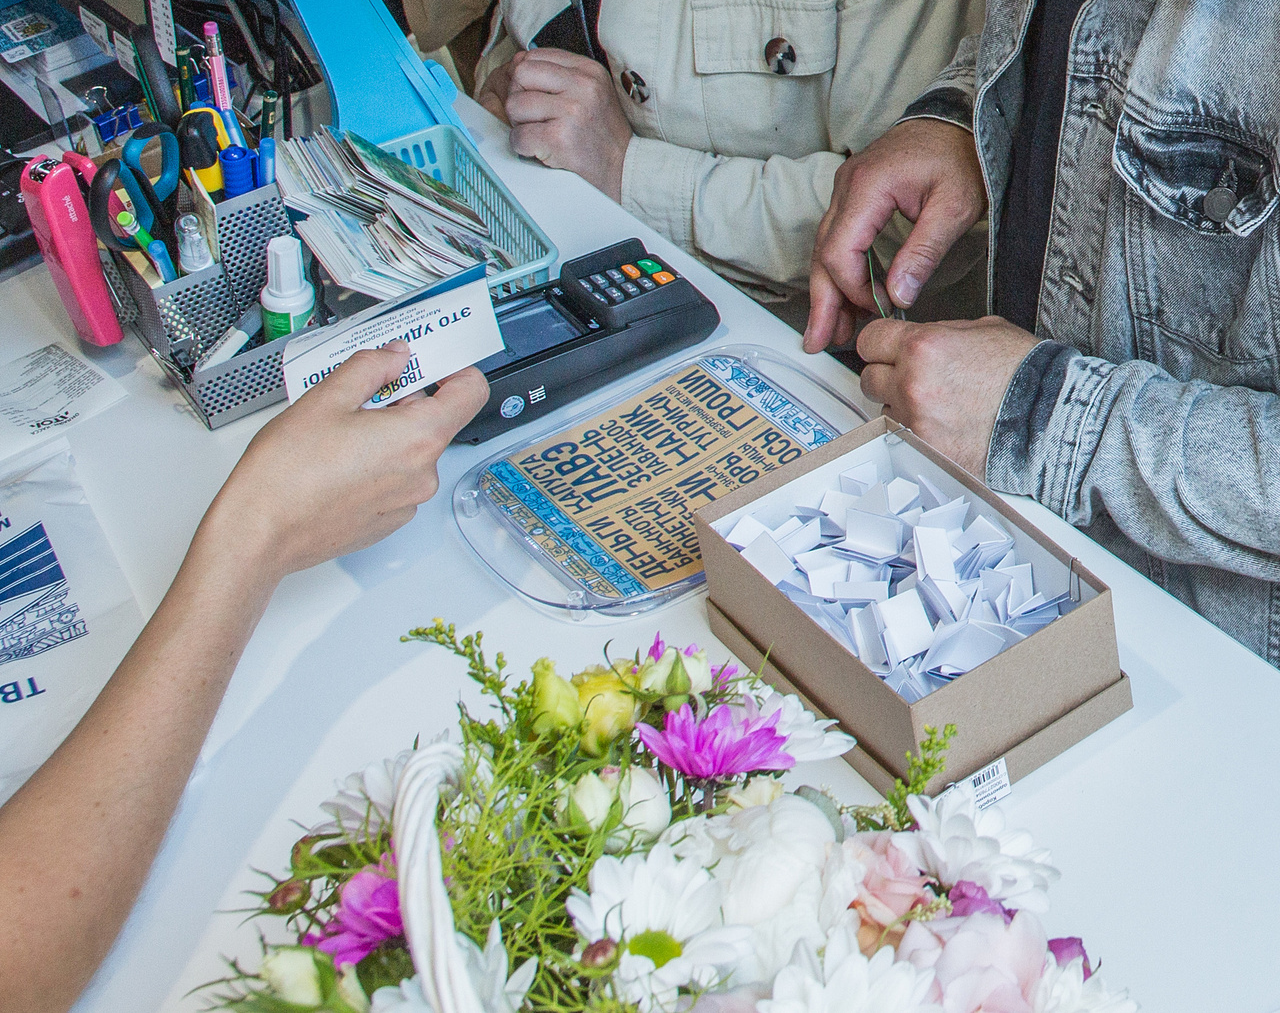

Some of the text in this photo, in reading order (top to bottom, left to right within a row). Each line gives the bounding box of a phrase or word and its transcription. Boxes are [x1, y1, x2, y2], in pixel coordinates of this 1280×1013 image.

[62, 194, 79, 223] attaché
[384, 313, 413, 328] только
[403, 307, 441, 327] Магазин,
[406, 306, 417, 314] но
[437, 305, 472, 328] ЭТО
[328, 342, 357, 359] можно
[358, 327, 394, 345] котором
[390, 368, 425, 392] ТВОЯ
[676, 367, 758, 431] ГРОШИ
[644, 390, 718, 451] ТУГРИКИ
[665, 383, 732, 439] ПРЕЗРЕННЫЙ МЕТАЛЛ
[578, 427, 652, 489] ЗЕЛЕНЬ
[598, 417, 672, 476] ЛАВАНДОС
[618, 403, 700, 467] НАЛИК
[518, 453, 593, 516] КАПУСТА
[540, 439, 629, 502] ЛАВЭ
[704, 463, 734, 487] ЗНАКИ
[655, 487, 696, 526] ЕЧКИ
[585, 514, 675, 578] ДЕНЬГИ
[615, 505, 694, 565] БАНКНОТЫ
